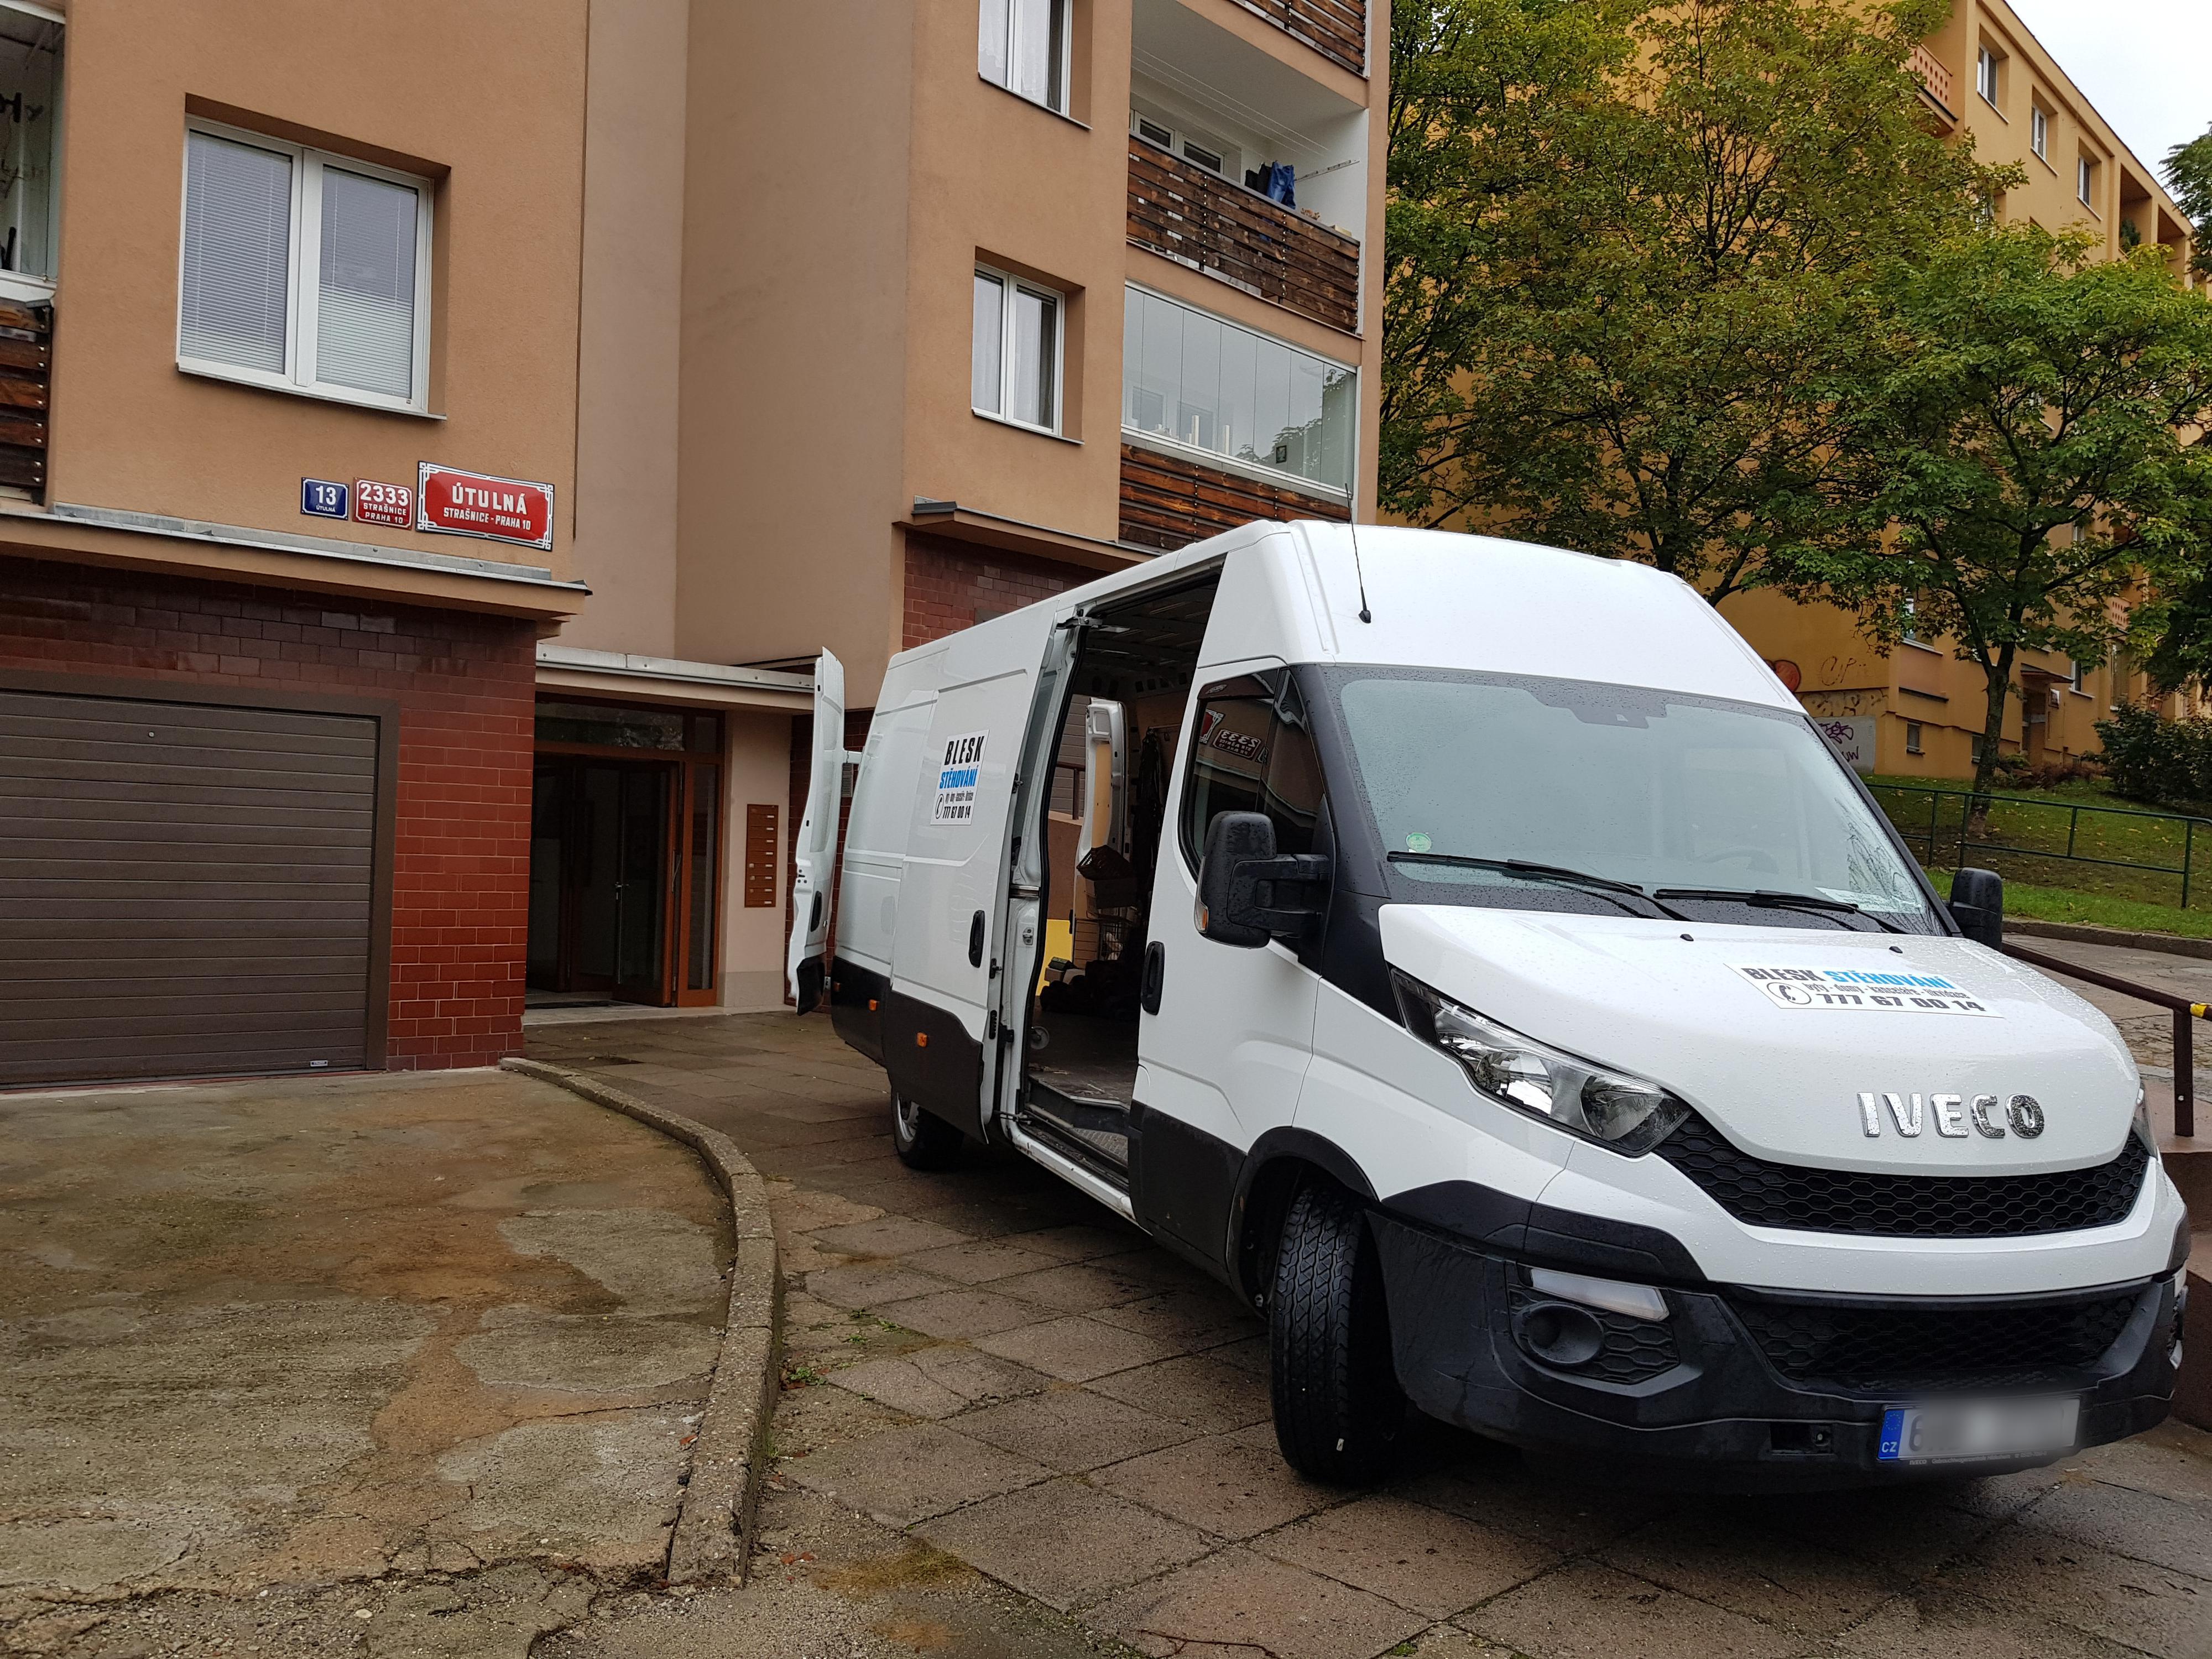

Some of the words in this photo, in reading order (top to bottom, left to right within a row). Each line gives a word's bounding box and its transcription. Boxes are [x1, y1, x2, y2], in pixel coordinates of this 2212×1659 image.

[316, 486, 336, 505] 13
[360, 483, 409, 506] 2333
[452, 482, 527, 515] ÚTULNÁ
[316, 504, 336, 513] ÚTULNÁ
[363, 503, 406, 515] STRAŠNICE
[365, 512, 390, 522] PRAHA
[444, 507, 489, 523] STRAŠNICE
[495, 514, 520, 529] PRAHA
[523, 520, 531, 530] 10
[944, 735, 984, 765] BLESK
[940, 765, 978, 789] STĚHOVÁNÍ
[942, 806, 951, 818] 777
[951, 806, 957, 818] 67
[957, 806, 964, 818] 00
[965, 806, 971, 818] 14
[1741, 968, 1827, 982] BLESK
[1823, 970, 1956, 989] STĚHOVÁNÍ
[1834, 984, 1865, 993] domy
[1815, 994, 1863, 1004] 777
[1870, 995, 1903, 1006] 67
[1910, 998, 1950, 1009] 00
[1952, 1000, 1986, 1011] 14
[1856, 1092, 2044, 1138] IVECO
[1882, 1441, 1897, 1452] CZ
